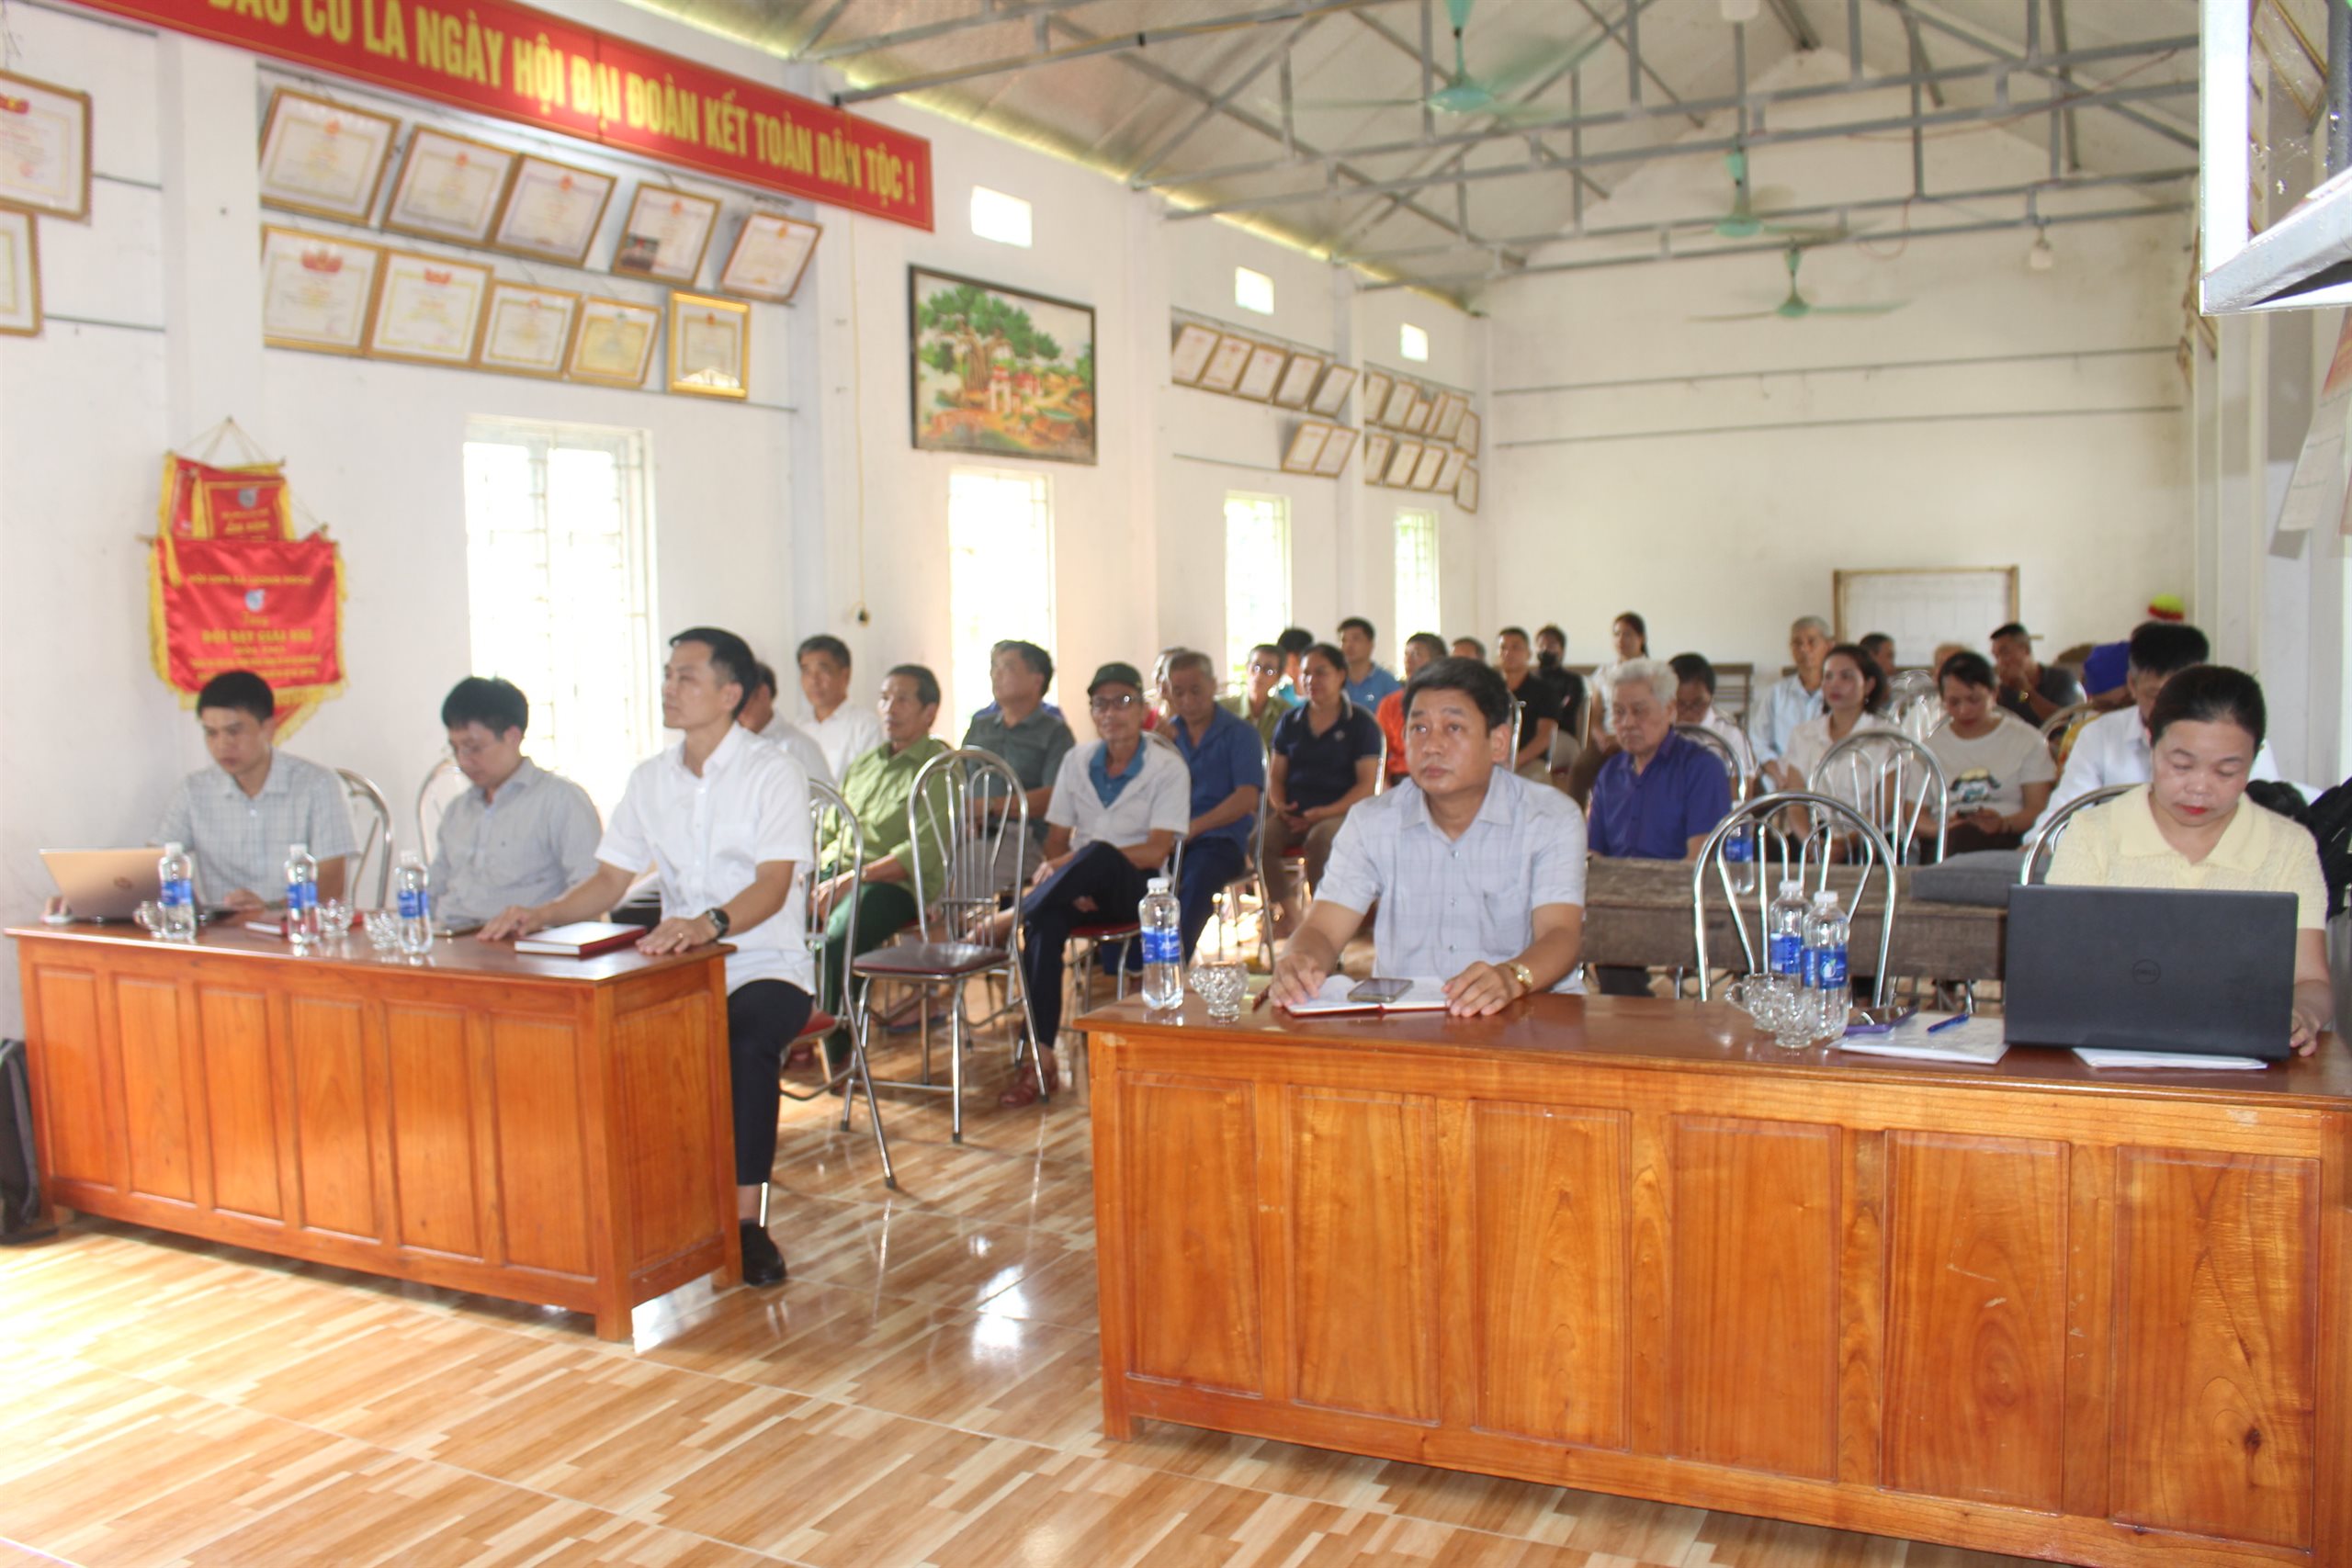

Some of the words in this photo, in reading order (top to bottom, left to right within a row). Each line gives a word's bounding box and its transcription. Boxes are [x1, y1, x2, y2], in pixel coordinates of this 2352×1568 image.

[415, 8, 504, 88] NGÀY
[512, 31, 566, 116] HỘI
[570, 53, 621, 131] ĐẠI
[626, 73, 699, 144] ĐOÀN
[704, 89, 749, 157] KẾT
[752, 110, 812, 175] TOÀN
[818, 127, 862, 189] DÂN
[865, 141, 903, 208] TỘC
